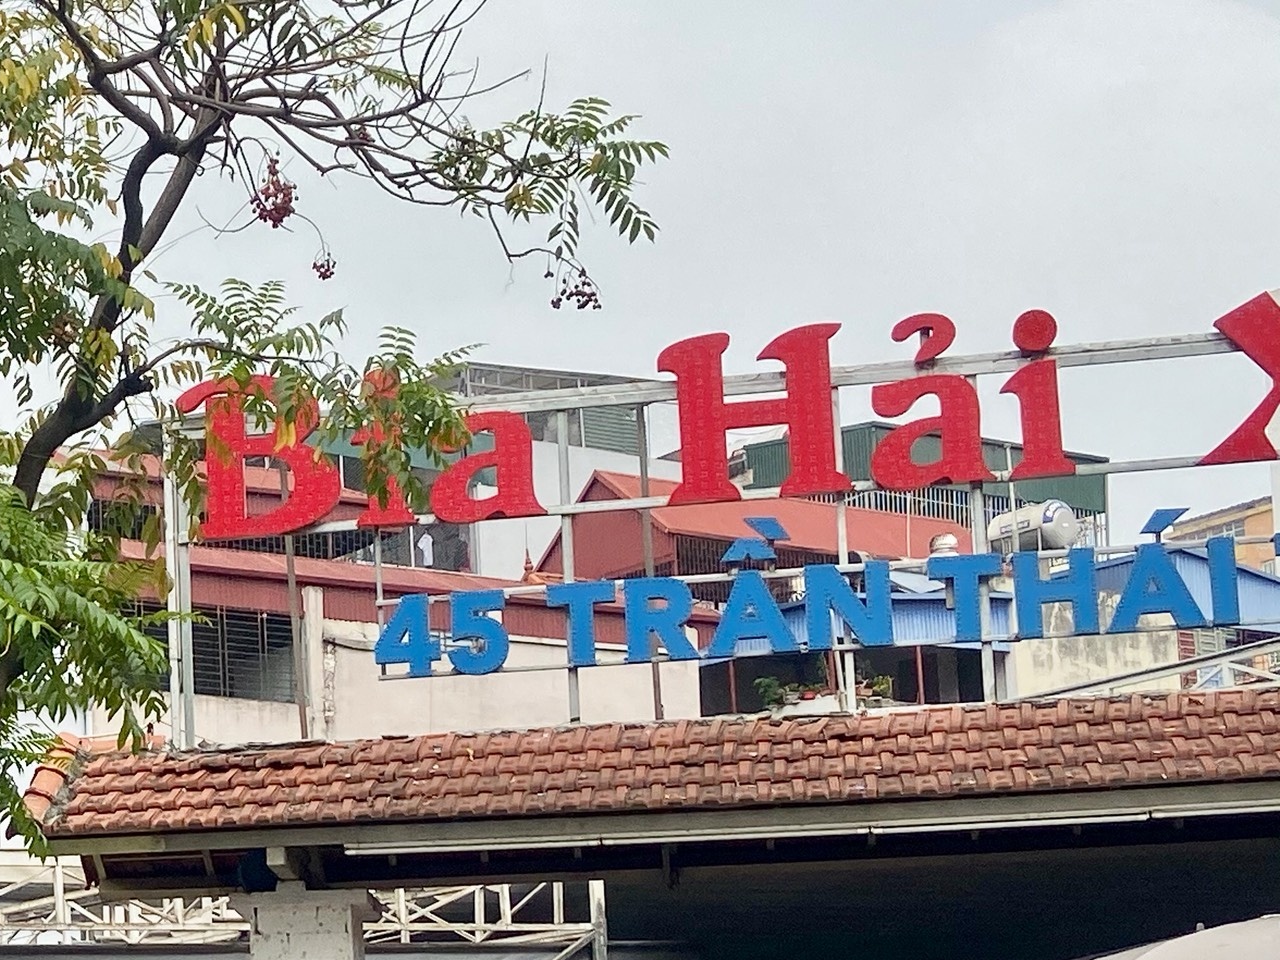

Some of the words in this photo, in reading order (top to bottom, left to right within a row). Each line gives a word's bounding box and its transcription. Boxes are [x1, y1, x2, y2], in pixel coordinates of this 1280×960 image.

[176, 367, 548, 540] Bia
[657, 309, 1077, 507] Hải
[375, 590, 511, 678] 45
[546, 516, 893, 667] TRẦN
[929, 508, 1240, 641] THÁI
